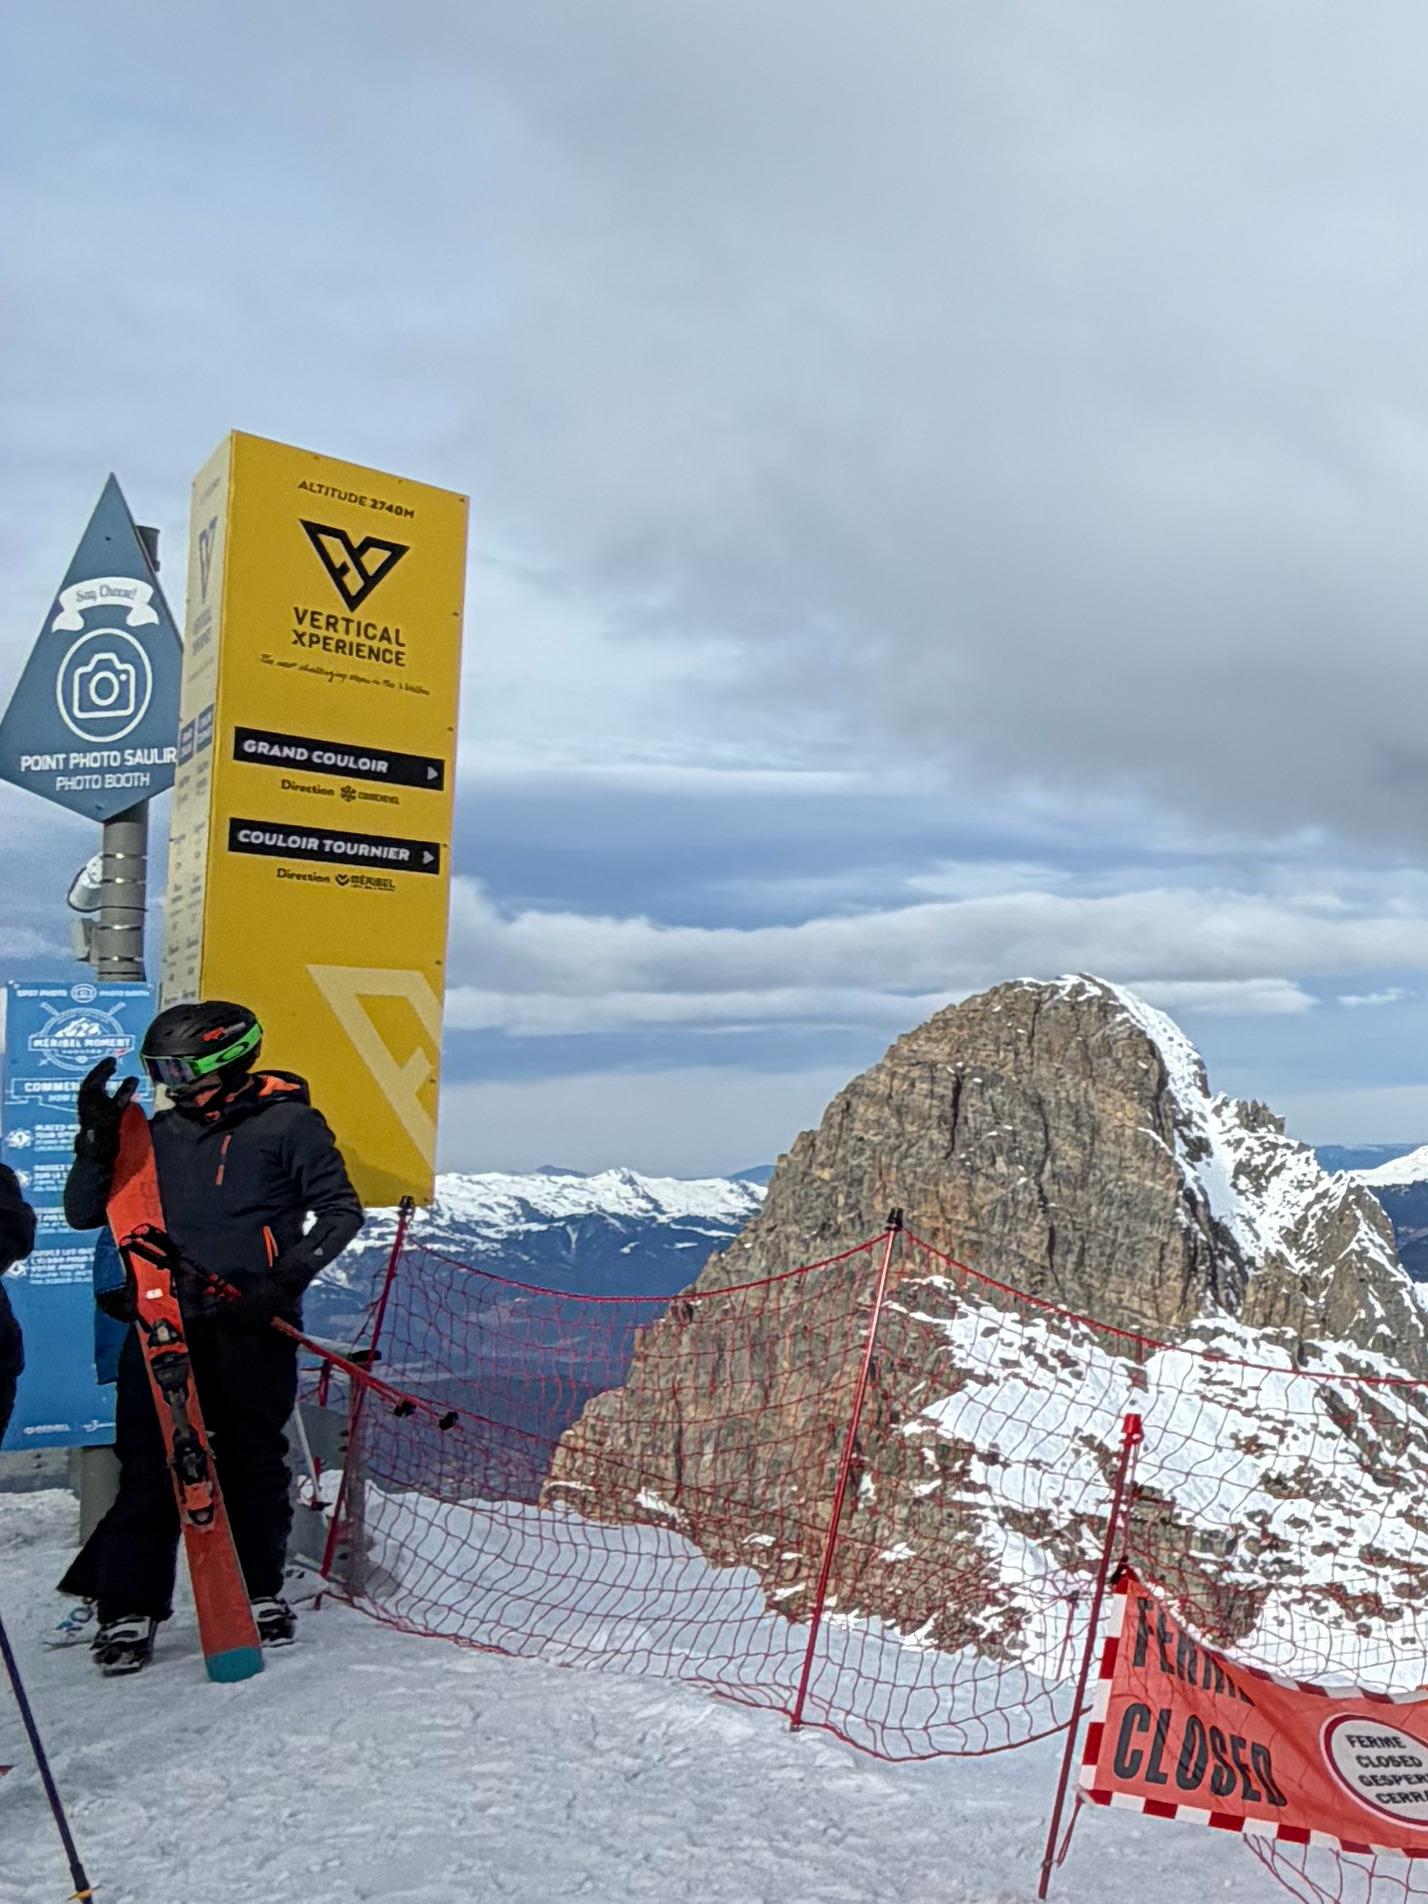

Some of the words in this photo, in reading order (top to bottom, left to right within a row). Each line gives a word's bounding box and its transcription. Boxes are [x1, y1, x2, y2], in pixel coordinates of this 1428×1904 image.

[298, 480, 366, 507] ALTITUDE
[369, 498, 415, 519] 2740M
[293, 606, 406, 647] VERTICAL
[291, 629, 406, 667] XPERIENCE
[20, 754, 66, 772] POINT
[69, 751, 121, 769] PHOTO
[124, 747, 178, 765] SAULIR
[243, 739, 308, 761] GRAND
[312, 750, 389, 773] COULOIR
[56, 775, 100, 791] PHOTO
[104, 772, 150, 789] BOOTH
[281, 779, 335, 796] Direction
[237, 829, 319, 852] COULOIR
[323, 839, 411, 862] TOURNIER
[277, 868, 330, 883] Direction
[1113, 1703, 1287, 1807] CLOSED
[1346, 1734, 1407, 1750] FERME
[1355, 1754, 1423, 1769] CLOSED
